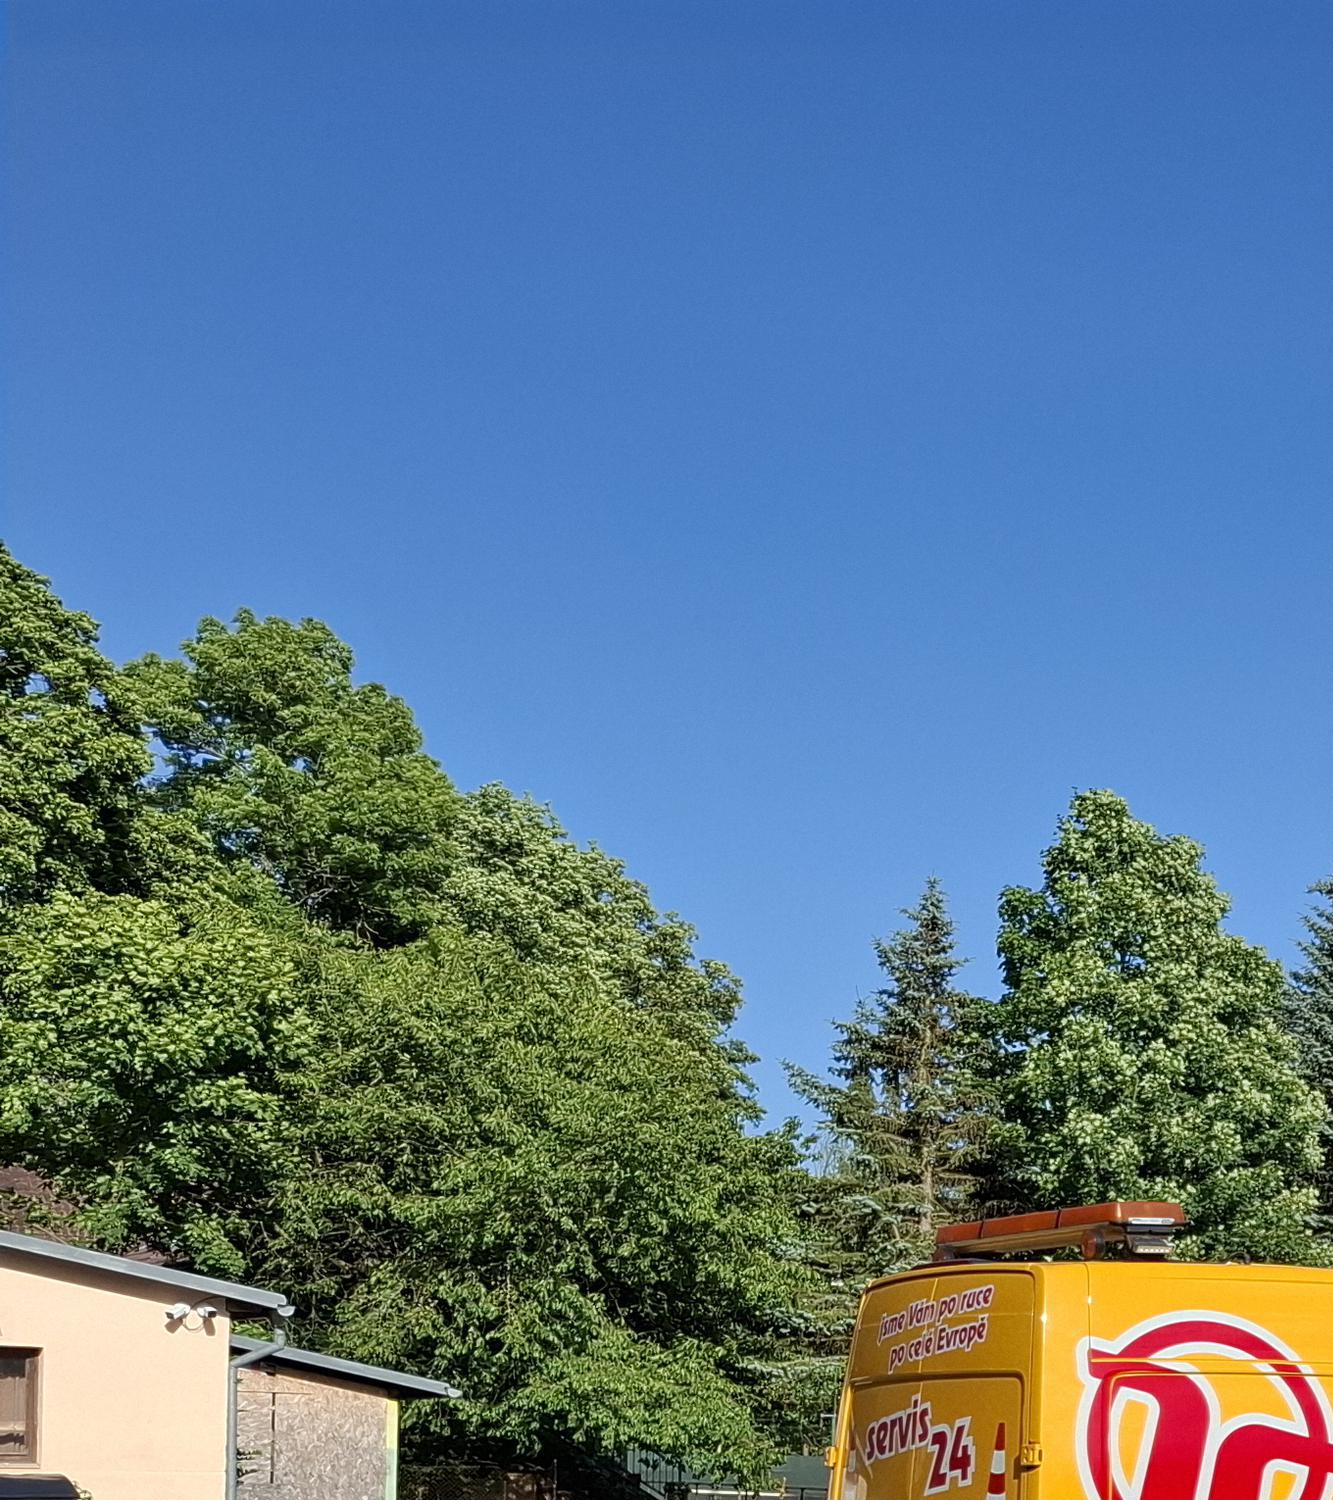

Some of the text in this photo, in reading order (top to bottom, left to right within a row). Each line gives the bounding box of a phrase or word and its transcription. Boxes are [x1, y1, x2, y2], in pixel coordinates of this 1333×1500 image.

[878, 1285, 994, 1343] jsme Vám po ruce
[888, 1314, 988, 1374] po celé Evropě
[866, 1396, 973, 1493] servis 24
